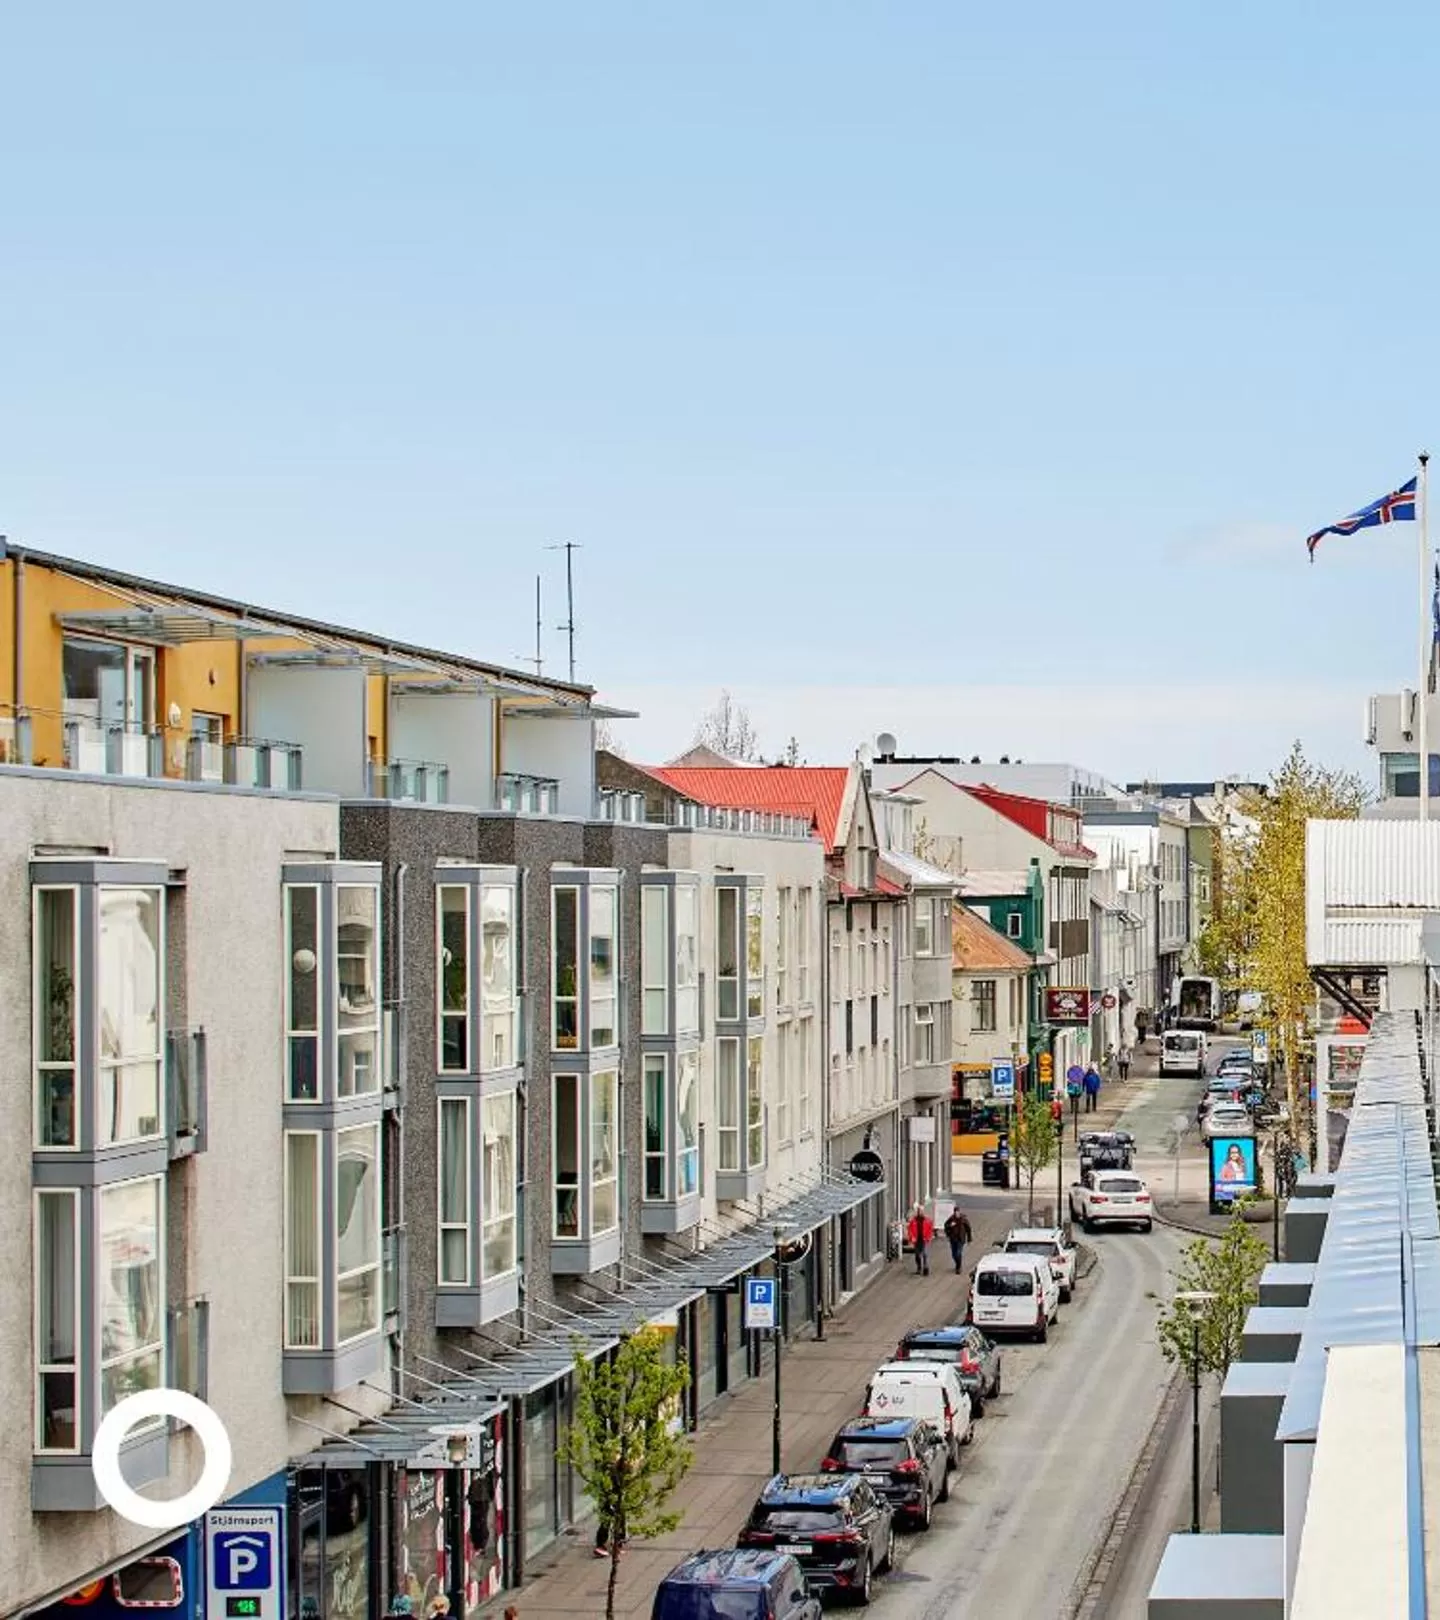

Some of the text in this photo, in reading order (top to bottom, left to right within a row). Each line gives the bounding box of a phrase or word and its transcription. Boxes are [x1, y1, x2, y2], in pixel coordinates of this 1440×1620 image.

[997, 1068, 1008, 1081] P
[755, 1285, 767, 1300] P
[229, 1548, 258, 1585] P
